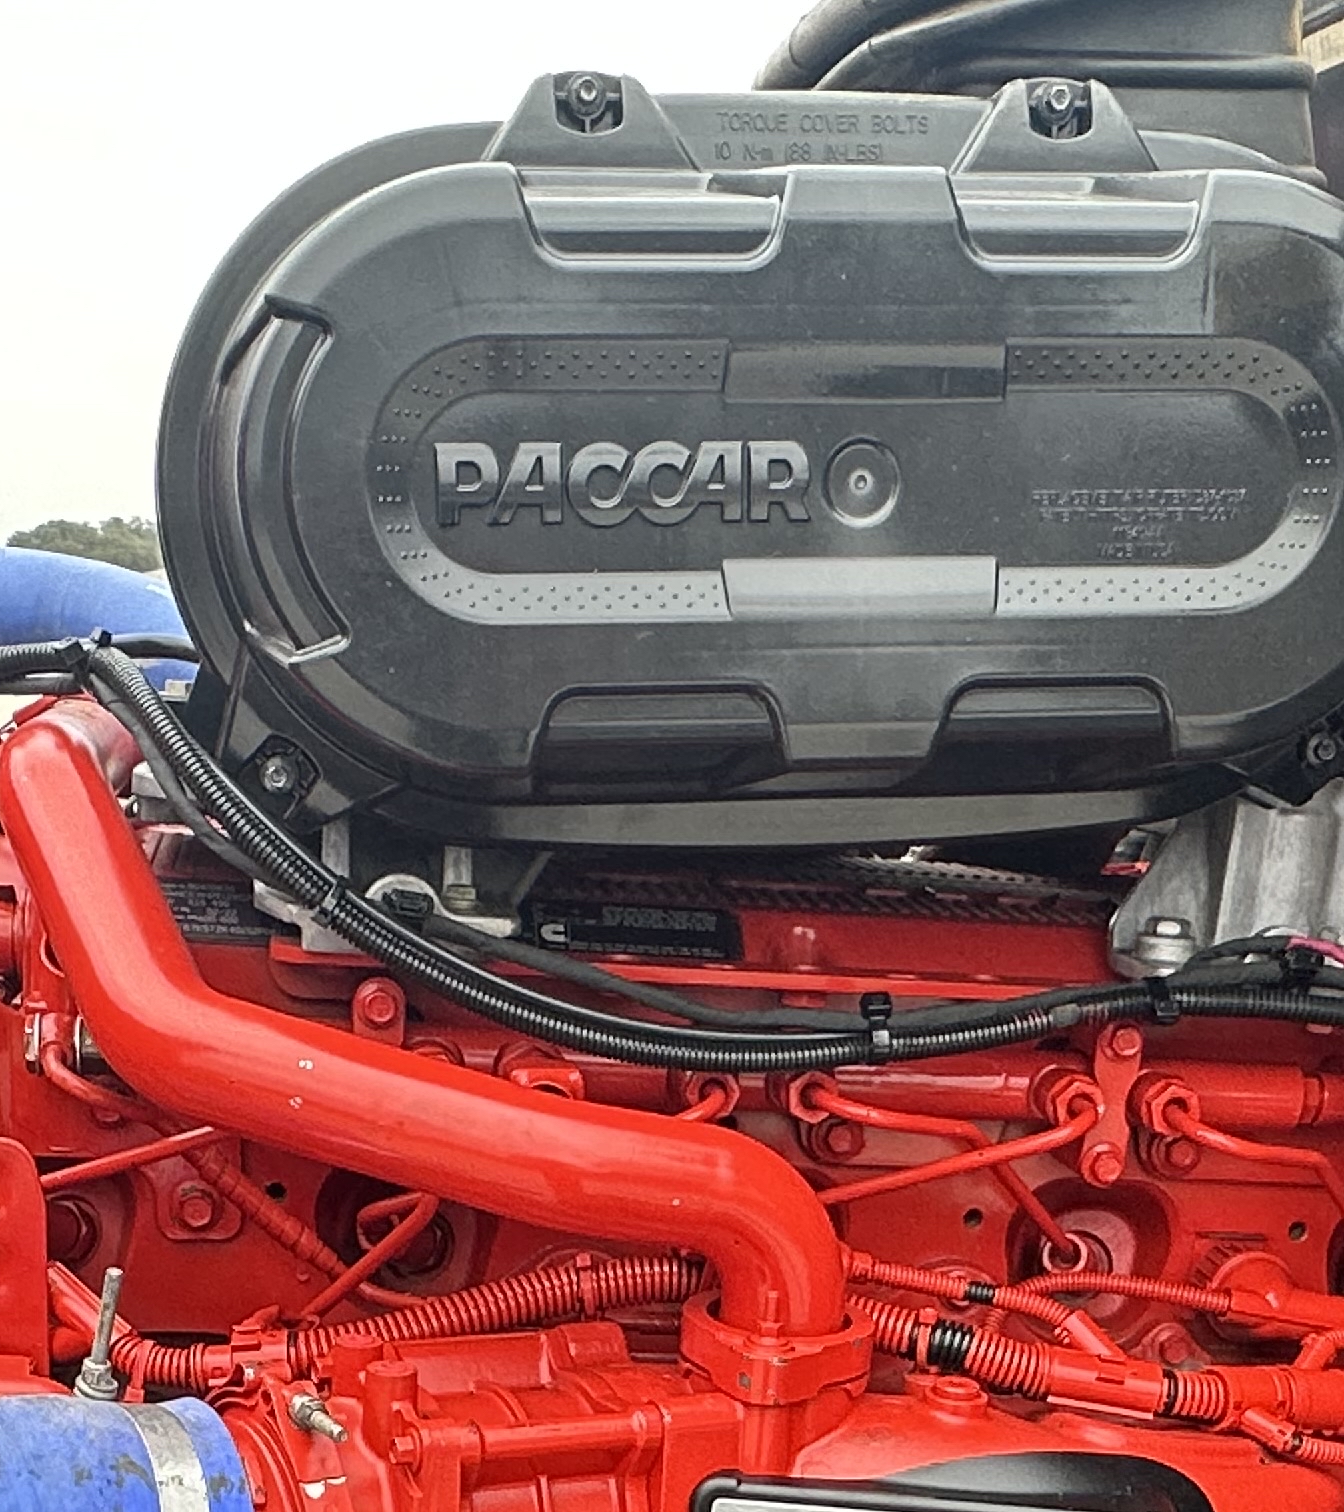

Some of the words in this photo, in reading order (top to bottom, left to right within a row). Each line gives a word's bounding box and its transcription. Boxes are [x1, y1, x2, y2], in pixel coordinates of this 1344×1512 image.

[715, 112, 788, 134] TORQUE
[799, 113, 860, 135] COVER
[870, 114, 929, 135] BOLTS
[714, 141, 732, 161] 10
[433, 440, 812, 529] PACCAR
